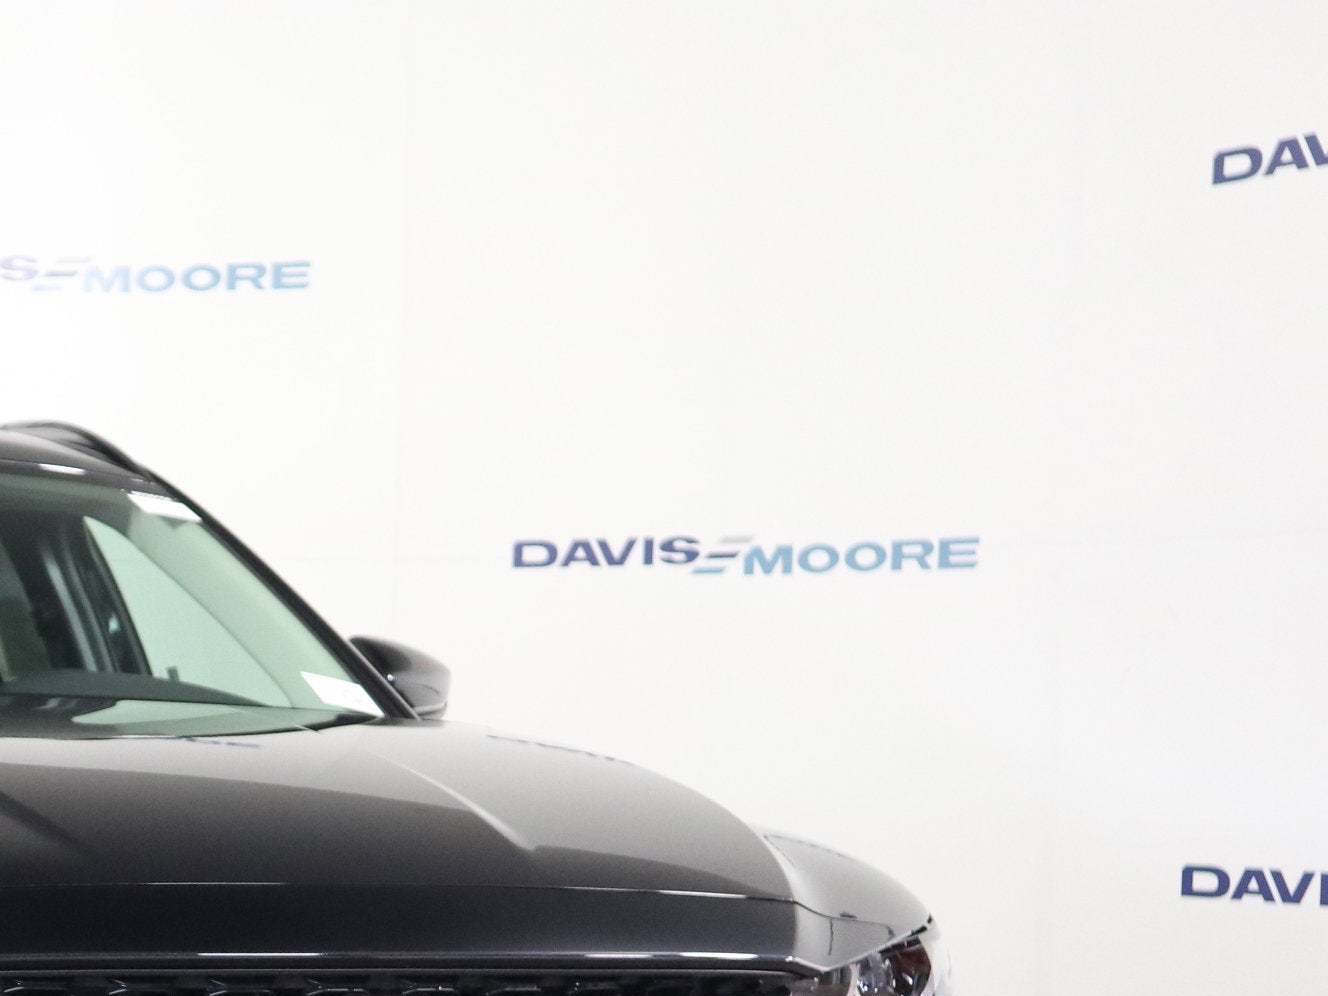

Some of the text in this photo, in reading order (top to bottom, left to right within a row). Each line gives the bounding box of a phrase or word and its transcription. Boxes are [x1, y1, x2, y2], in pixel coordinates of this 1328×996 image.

[84, 261, 311, 293] MOORE
[511, 536, 980, 576] DAVIS MOORE
